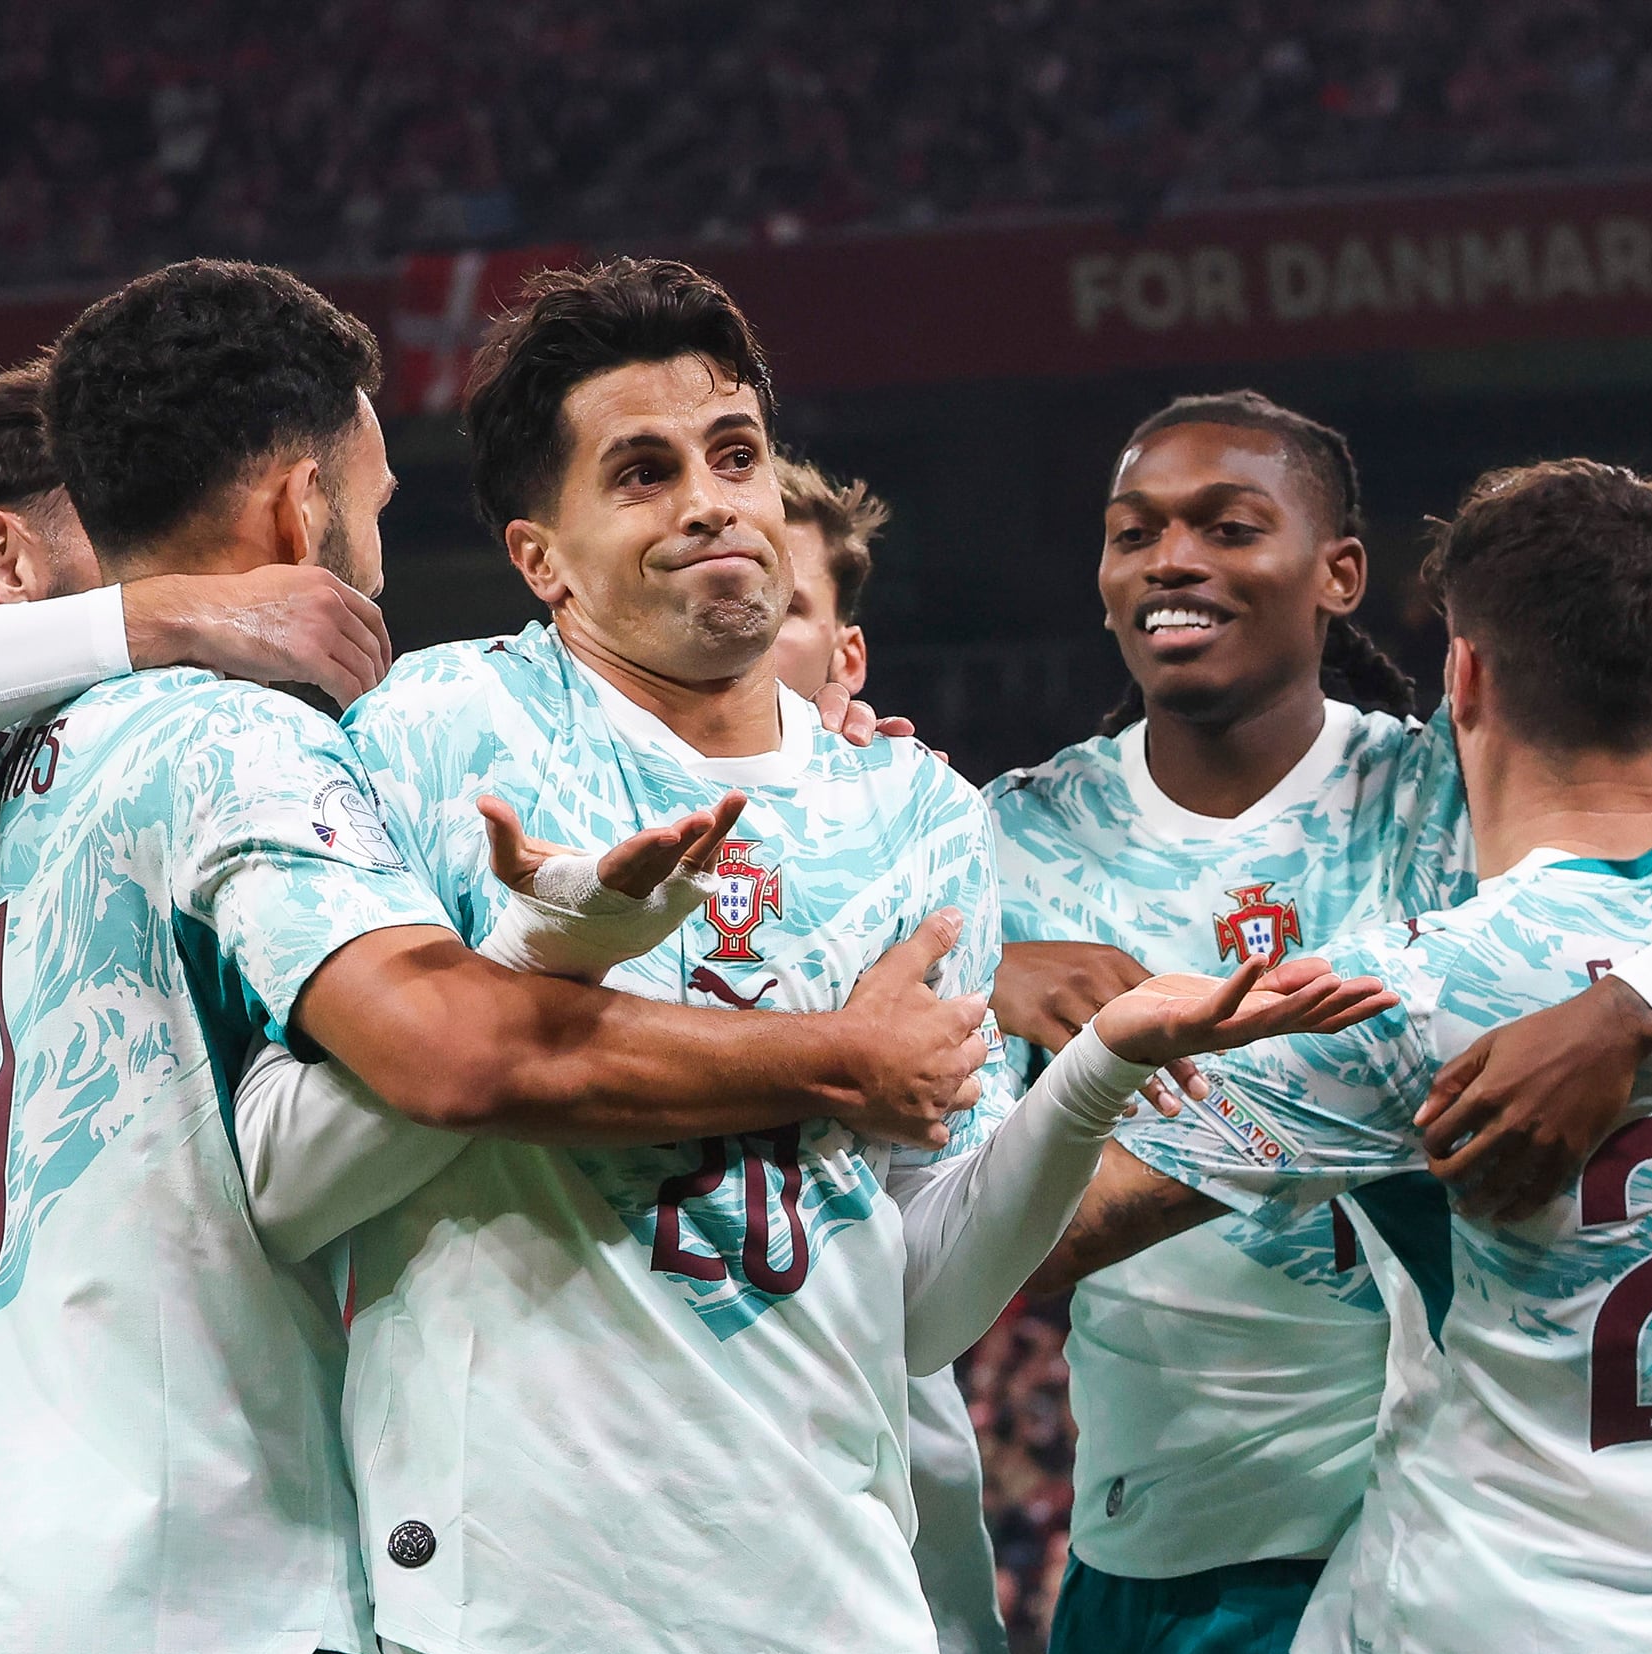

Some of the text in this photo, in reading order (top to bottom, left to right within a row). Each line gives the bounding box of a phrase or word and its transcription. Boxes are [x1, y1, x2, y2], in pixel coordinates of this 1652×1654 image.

[1070, 246, 1248, 332] FOR
[1208, 1090, 1292, 1168] UNDATION
[650, 1123, 809, 1295] 20
